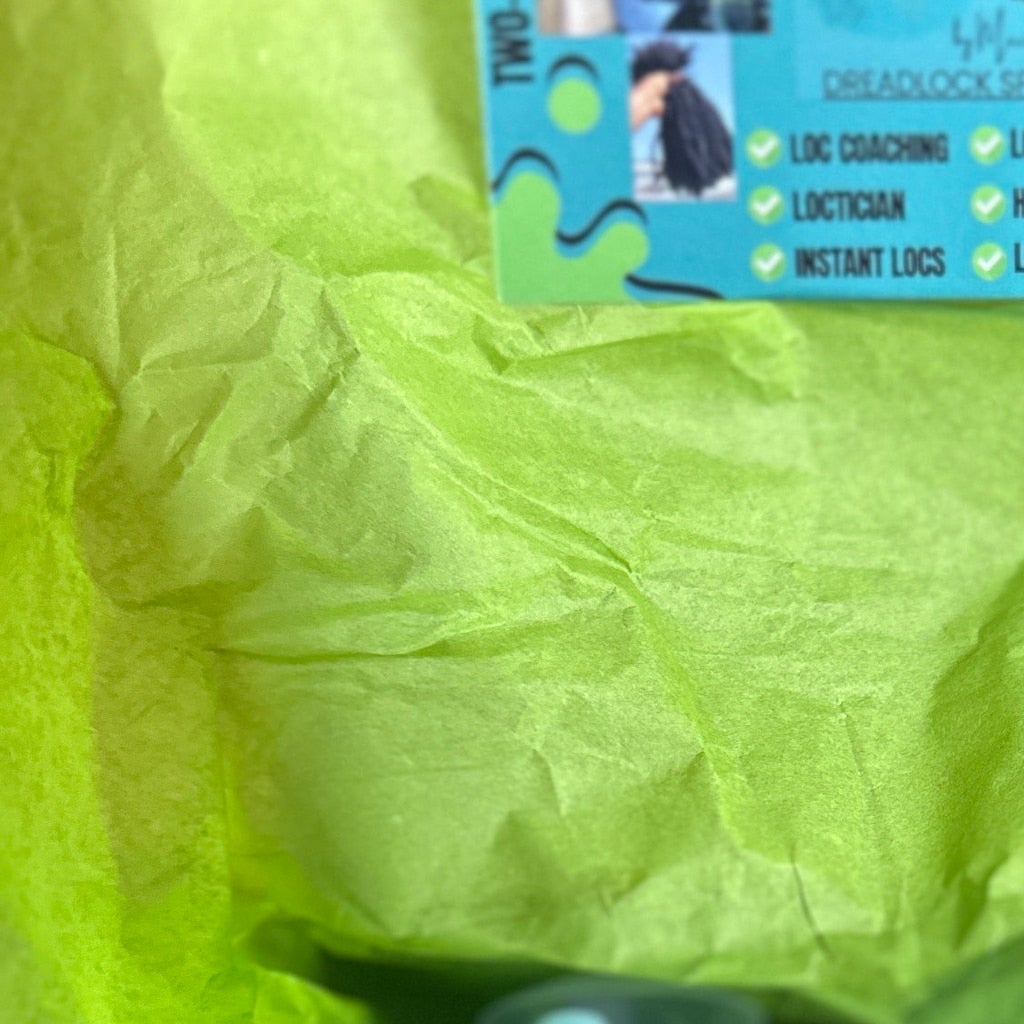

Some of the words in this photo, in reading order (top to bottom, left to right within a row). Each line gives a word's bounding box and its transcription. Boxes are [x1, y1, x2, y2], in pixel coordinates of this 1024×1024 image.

[823, 69, 991, 99] DREADLOCK
[790, 131, 832, 164] LOC
[839, 131, 949, 164] COACHING
[792, 190, 906, 222] LOCTICIAN
[795, 246, 884, 278] INSTANT
[891, 246, 946, 278] LOCS
